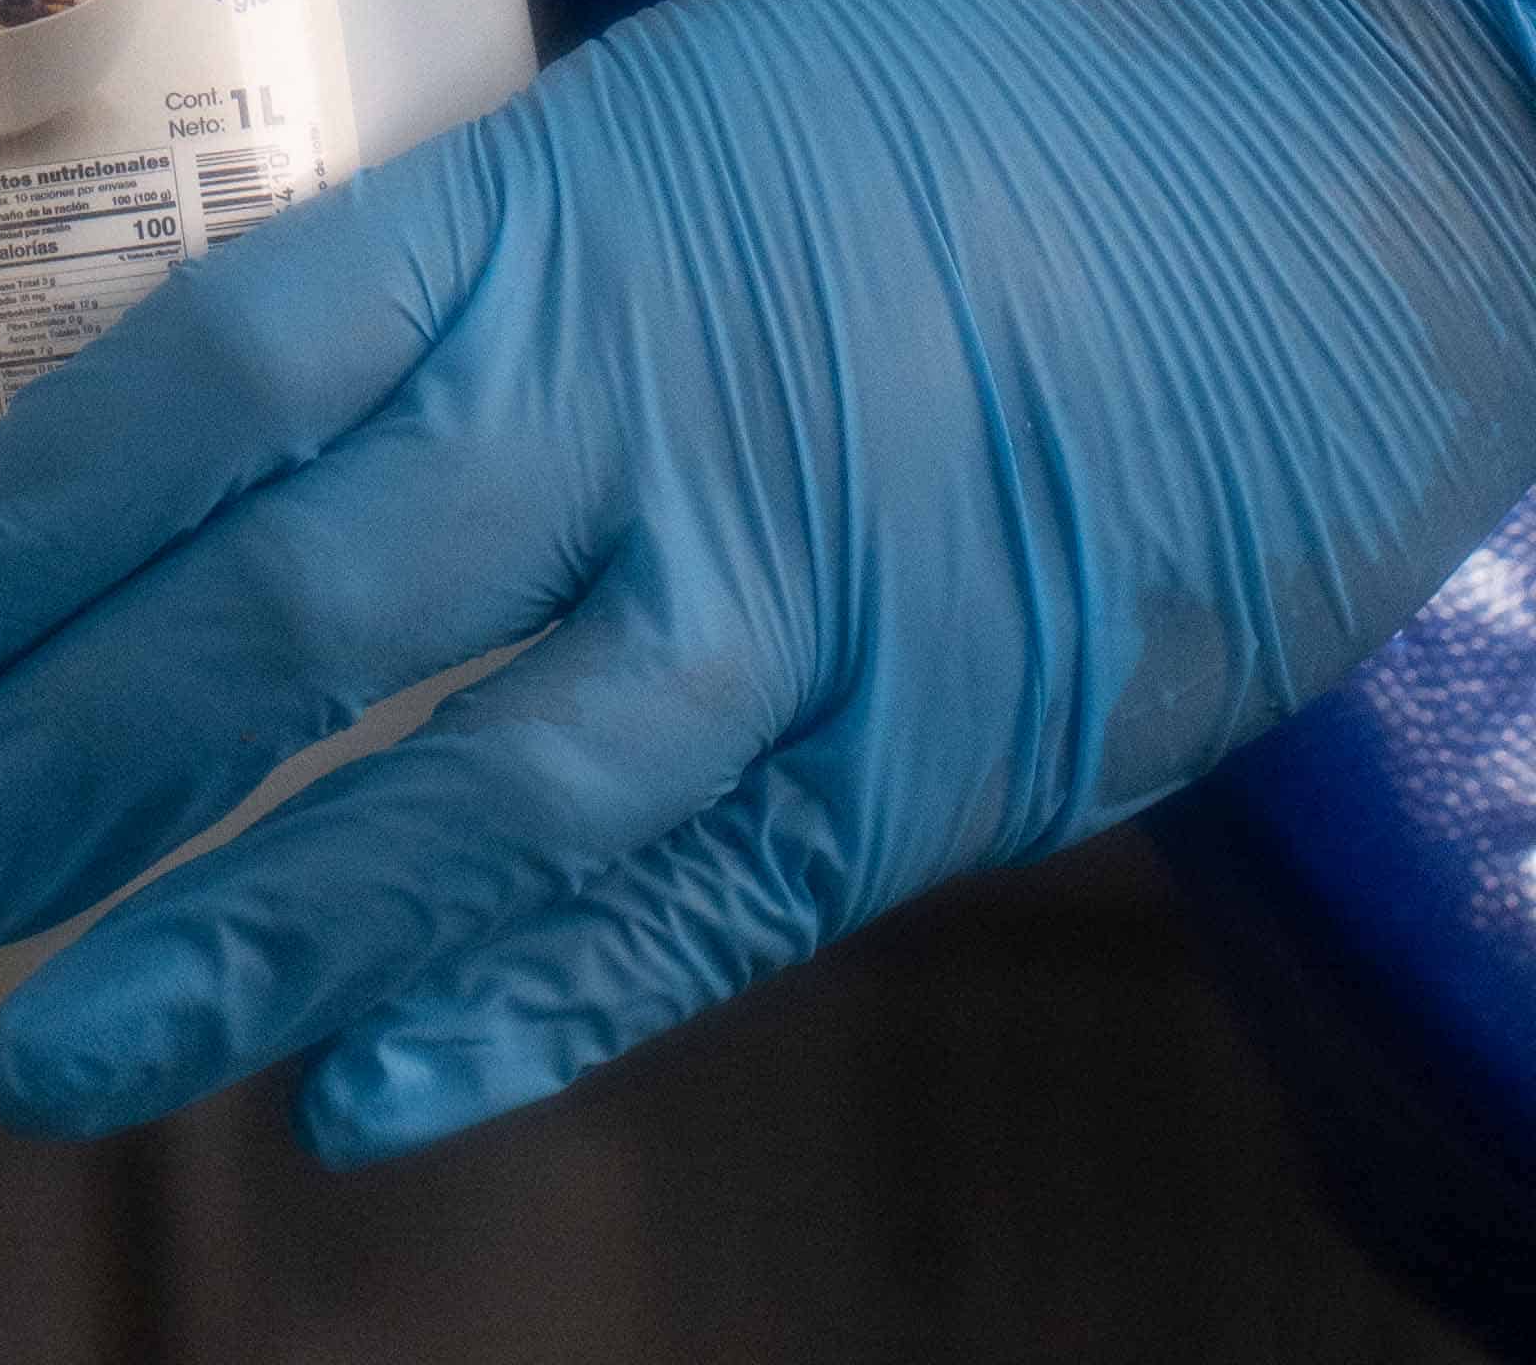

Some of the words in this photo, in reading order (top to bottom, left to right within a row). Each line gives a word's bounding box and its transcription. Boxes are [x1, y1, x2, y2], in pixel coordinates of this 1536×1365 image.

[165, 87, 224, 111] Cont.
[230, 88, 252, 130] 1
[260, 85, 286, 125] L
[168, 118, 226, 140] Neto:
[37, 154, 171, 186] nutricionales
[15, 193, 27, 205] 10
[30, 187, 75, 203] raciones
[77, 185, 95, 198] por
[98, 180, 138, 193] envase
[26, 205, 40, 217] de
[42, 203, 52, 215] la
[54, 200, 90, 216] ración
[112, 195, 132, 207] 100
[134, 190, 158, 206] (100
[159, 187, 172, 203] g)
[133, 215, 177, 241] 100
